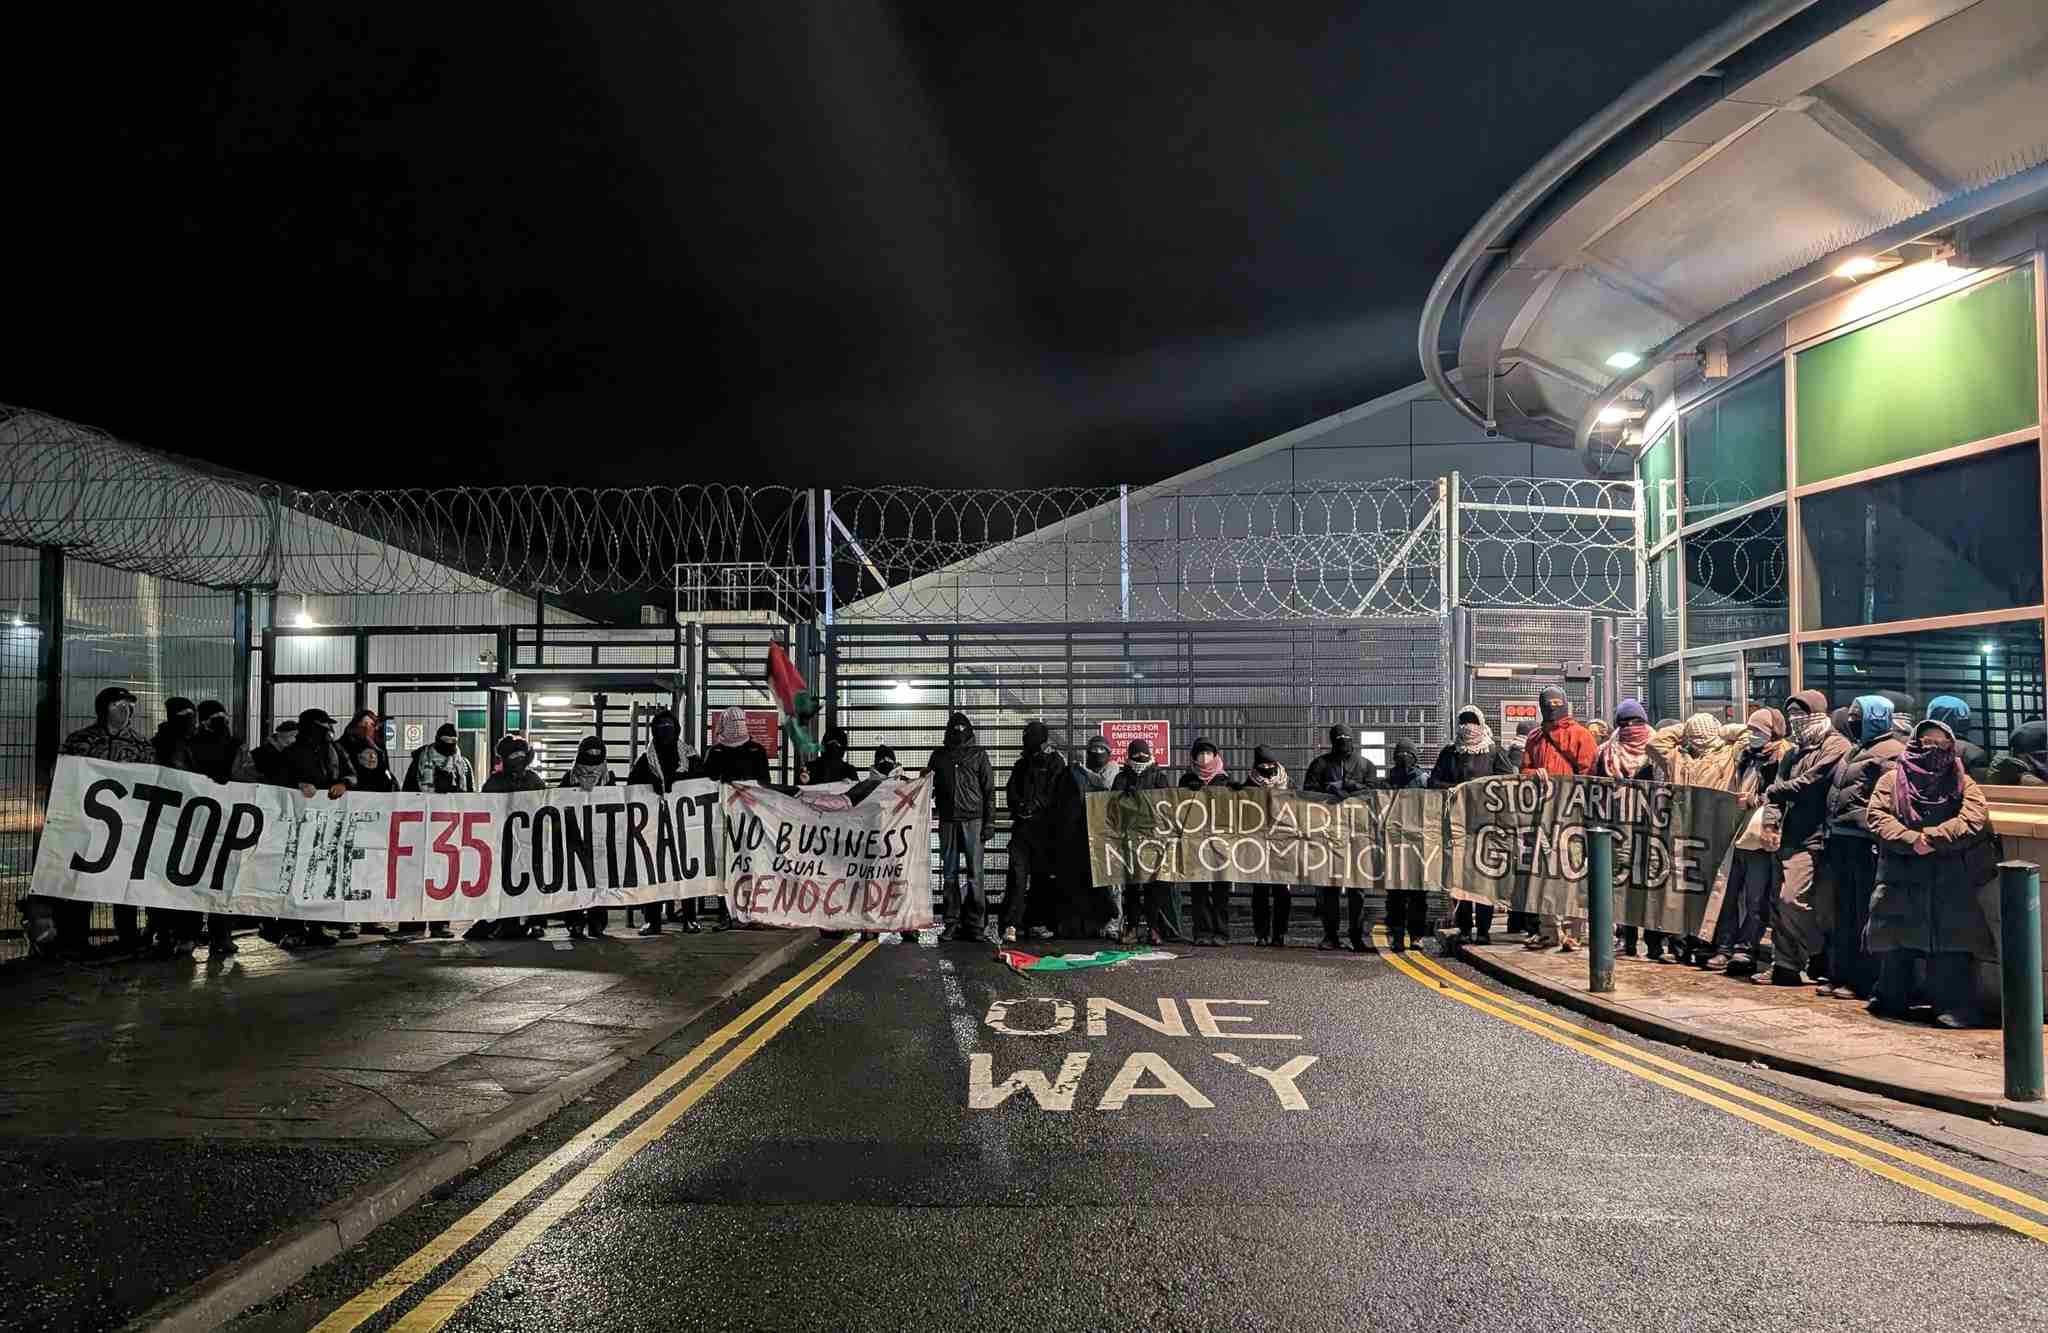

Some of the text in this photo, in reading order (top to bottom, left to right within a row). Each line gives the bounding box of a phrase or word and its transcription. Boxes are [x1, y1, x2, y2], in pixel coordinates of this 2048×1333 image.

[1111, 723, 1159, 732] ACCESS FOR
[1111, 732, 1159, 740] EMERGENCY
[1154, 798, 1391, 839] SOLIDARITY
[1484, 779, 1672, 828] STOP ARMING
[68, 778, 720, 901] STOP THE F35 CONTRACT
[727, 812, 912, 860] NO BUSINESS
[731, 854, 904, 879] AS USUAL DURING
[1104, 836, 1441, 882] NOT COMPLICITY
[733, 874, 909, 919] GENOCIDE
[984, 998, 1303, 1040] ONE
[967, 1052, 1321, 1111] WAY
